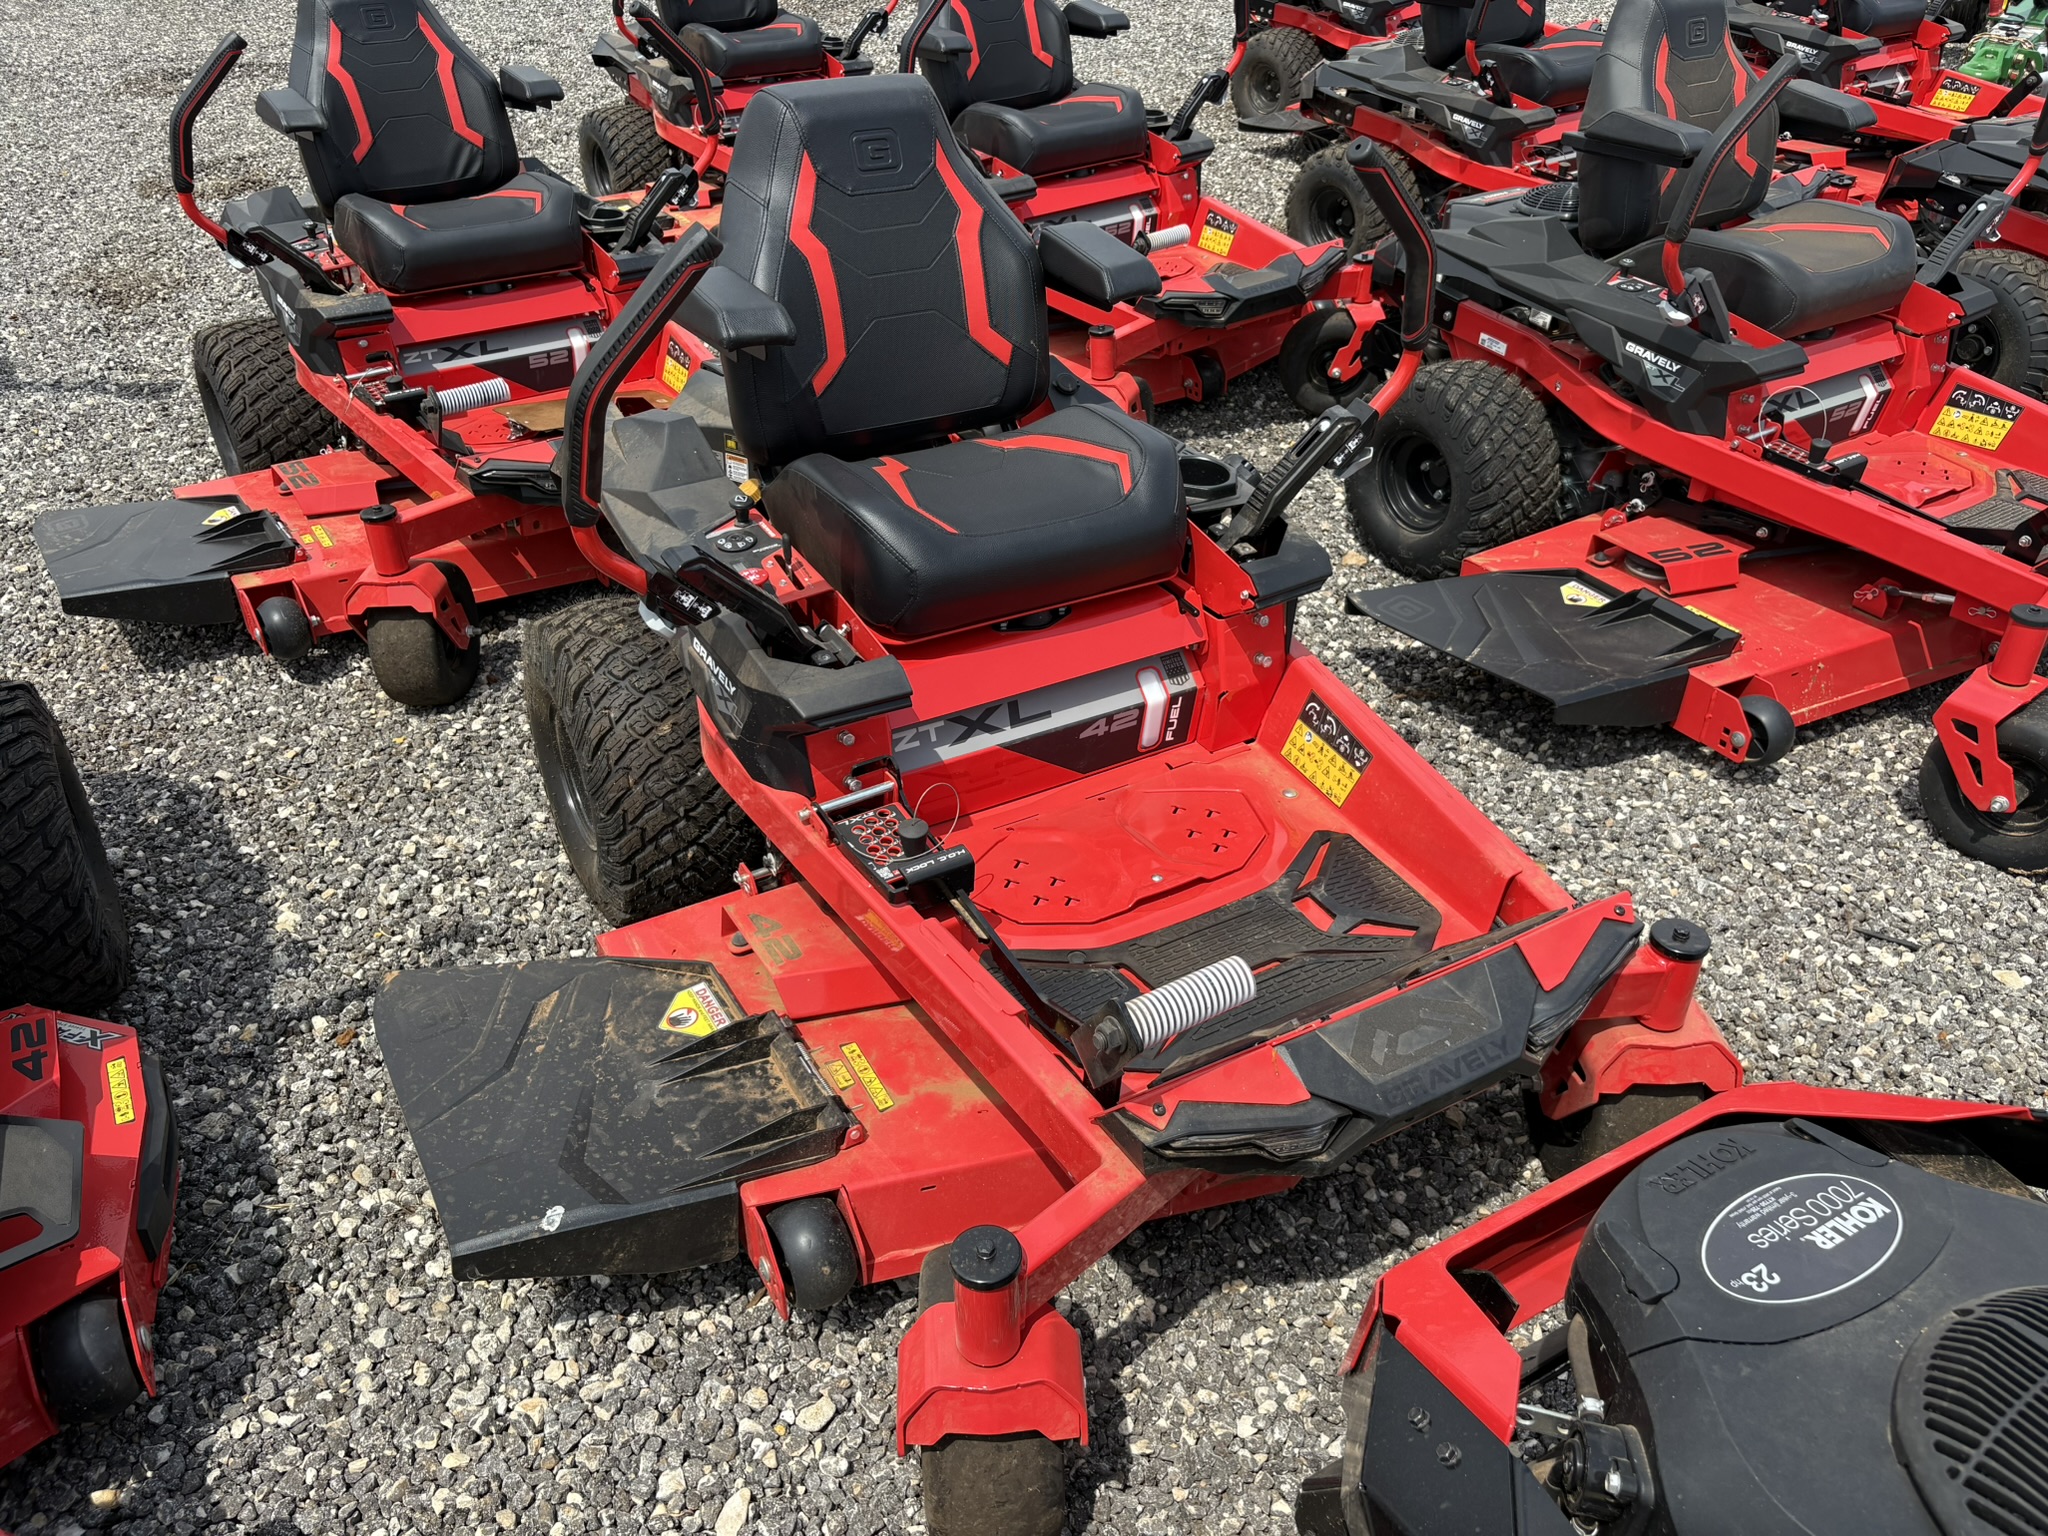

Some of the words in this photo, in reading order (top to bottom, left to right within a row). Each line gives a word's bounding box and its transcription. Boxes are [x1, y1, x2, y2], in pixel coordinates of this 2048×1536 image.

[1786, 40, 1819, 55] GRAVELY
[1452, 113, 1485, 130] GRAVELY
[403, 348, 438, 365] ZT
[438, 340, 509, 362] XL
[528, 350, 569, 369] 52
[1625, 341, 1682, 373] GRAVELY
[1651, 368, 1686, 393] XL
[1829, 400, 1863, 423] 52
[1862, 394, 1884, 430] FUEL
[277, 460, 321, 490] 52
[1647, 542, 1734, 564] 52
[1572, 583, 1606, 603] DANGER
[693, 636, 736, 696] GRAVELY
[893, 720, 945, 753] ZT
[945, 699, 1052, 748] XL
[1079, 708, 1140, 740] 42
[1165, 696, 1182, 741] FUEL
[905, 859, 935, 874] LOCK
[748, 912, 803, 967] 42
[696, 988, 727, 1028] DANGER
[11, 1018, 48, 1082] 42
[1386, 1034, 1511, 1104] GRAVELY
[1646, 1138, 1757, 1194] KOHLER
[1806, 1180, 1865, 1217] 7000
[1736, 1212, 1762, 1229] warranty
[1747, 1207, 1818, 1249] Series
[1730, 1278, 1745, 1288] hp
[1741, 1263, 1781, 1293] 23
